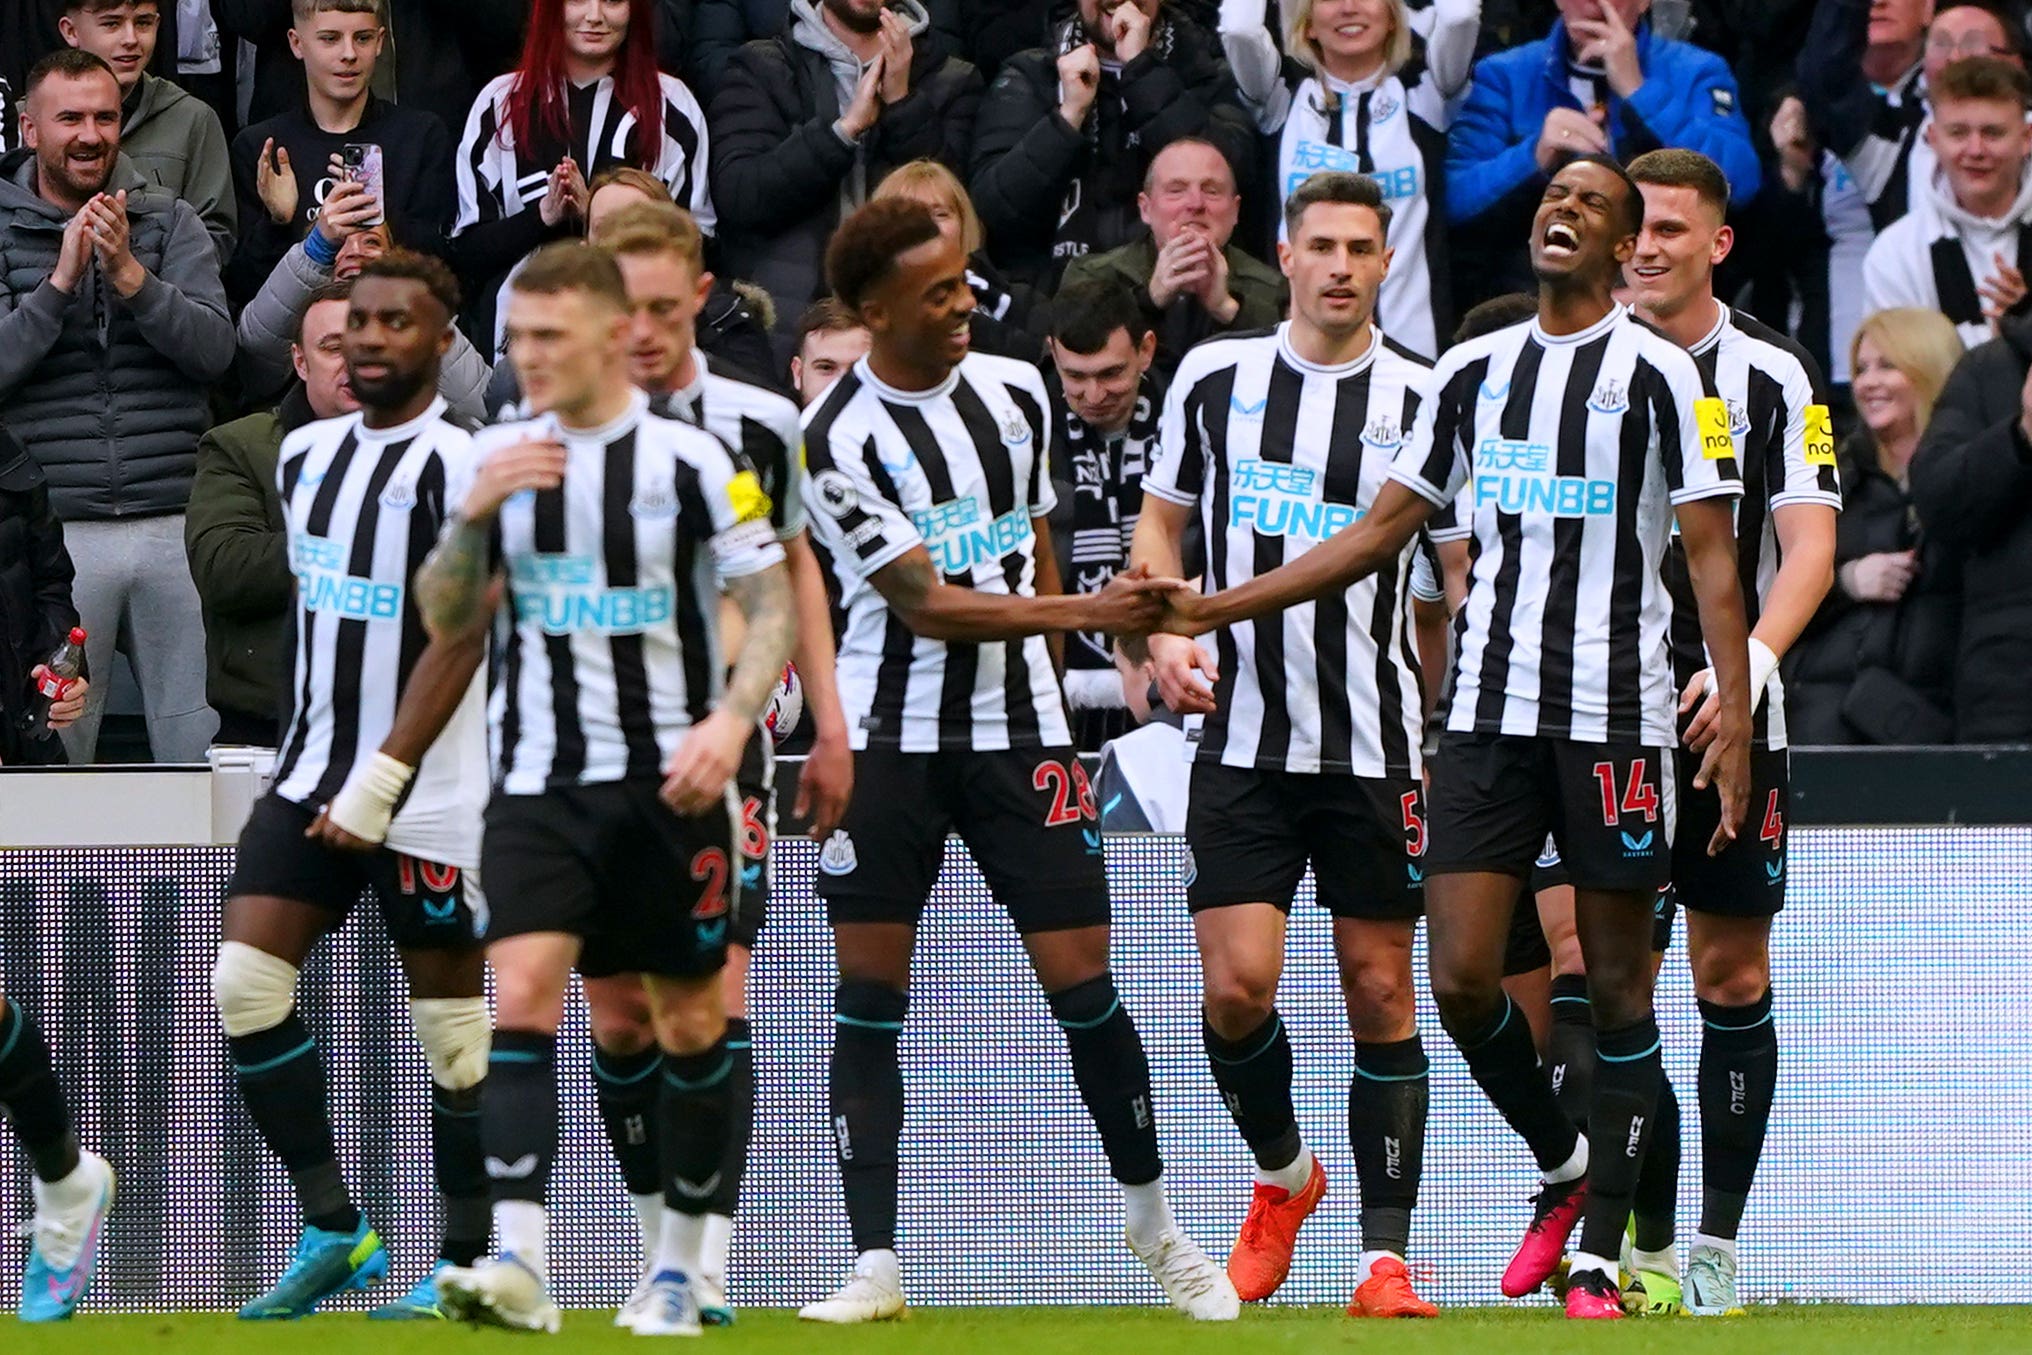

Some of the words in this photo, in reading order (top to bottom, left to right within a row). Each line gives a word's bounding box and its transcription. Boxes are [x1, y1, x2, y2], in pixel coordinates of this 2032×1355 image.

[1477, 439, 1549, 471] 乐天堂
[1233, 459, 1315, 496] 乐天堂
[1476, 475, 1615, 514] FUN88
[516, 588, 669, 627] FUN88
[1032, 758, 1096, 827] 28
[1593, 758, 1659, 827] 14
[1400, 790, 1424, 857] 5
[1759, 787, 1783, 850] 4
[690, 847, 729, 920] 2
[1729, 1070, 1745, 1115] NUFC
[1384, 1136, 1401, 1179] NUFC
[1625, 1115, 1645, 1158] NUFC
